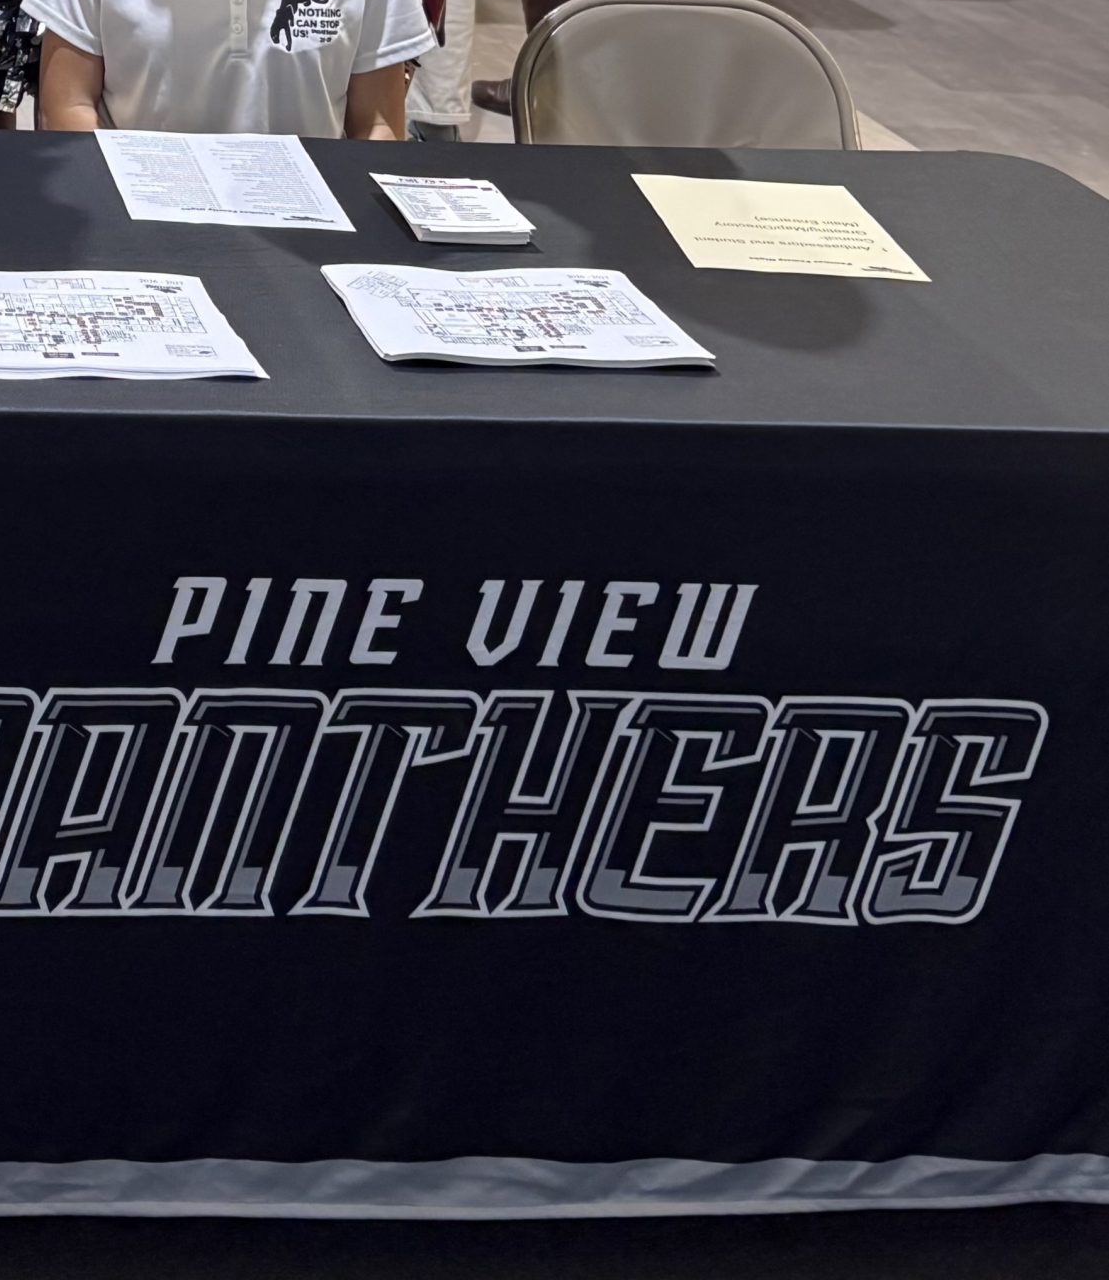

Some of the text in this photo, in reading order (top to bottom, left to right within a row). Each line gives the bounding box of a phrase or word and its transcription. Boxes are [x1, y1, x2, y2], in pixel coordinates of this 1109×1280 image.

[298, 8, 341, 18] NOTHING
[296, 19, 339, 29] CAN STOP
[292, 29, 309, 38] US!
[754, 216, 859, 228] (Main Entrance)
[714, 221, 867, 236] Greeting/Map/Directory
[693, 236, 746, 245] Student
[778, 239, 871, 251] Ambassadors
[151, 577, 759, 670] PINE VIEW
